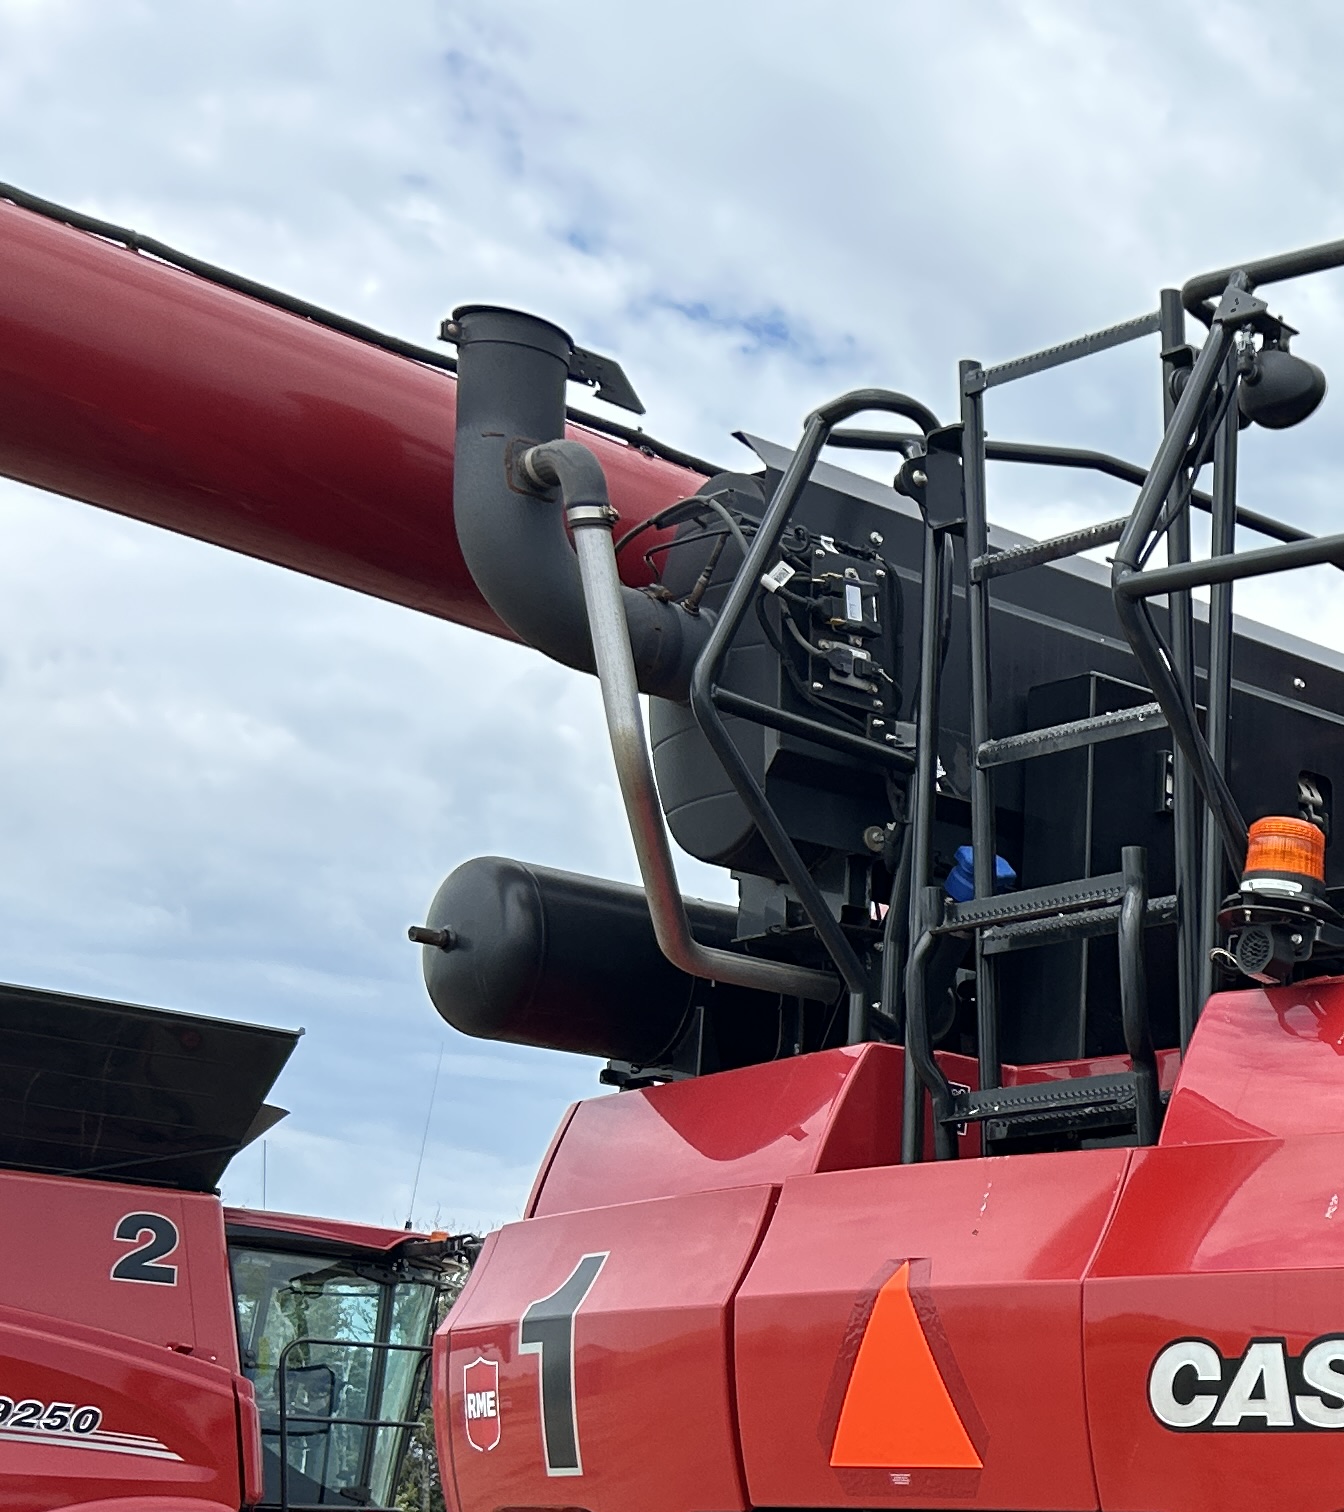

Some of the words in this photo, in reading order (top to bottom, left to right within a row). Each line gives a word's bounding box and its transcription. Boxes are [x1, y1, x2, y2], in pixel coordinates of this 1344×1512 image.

[110, 1211, 181, 1287] 2
[517, 1251, 611, 1478] 1
[466, 1390, 497, 1420] RME
